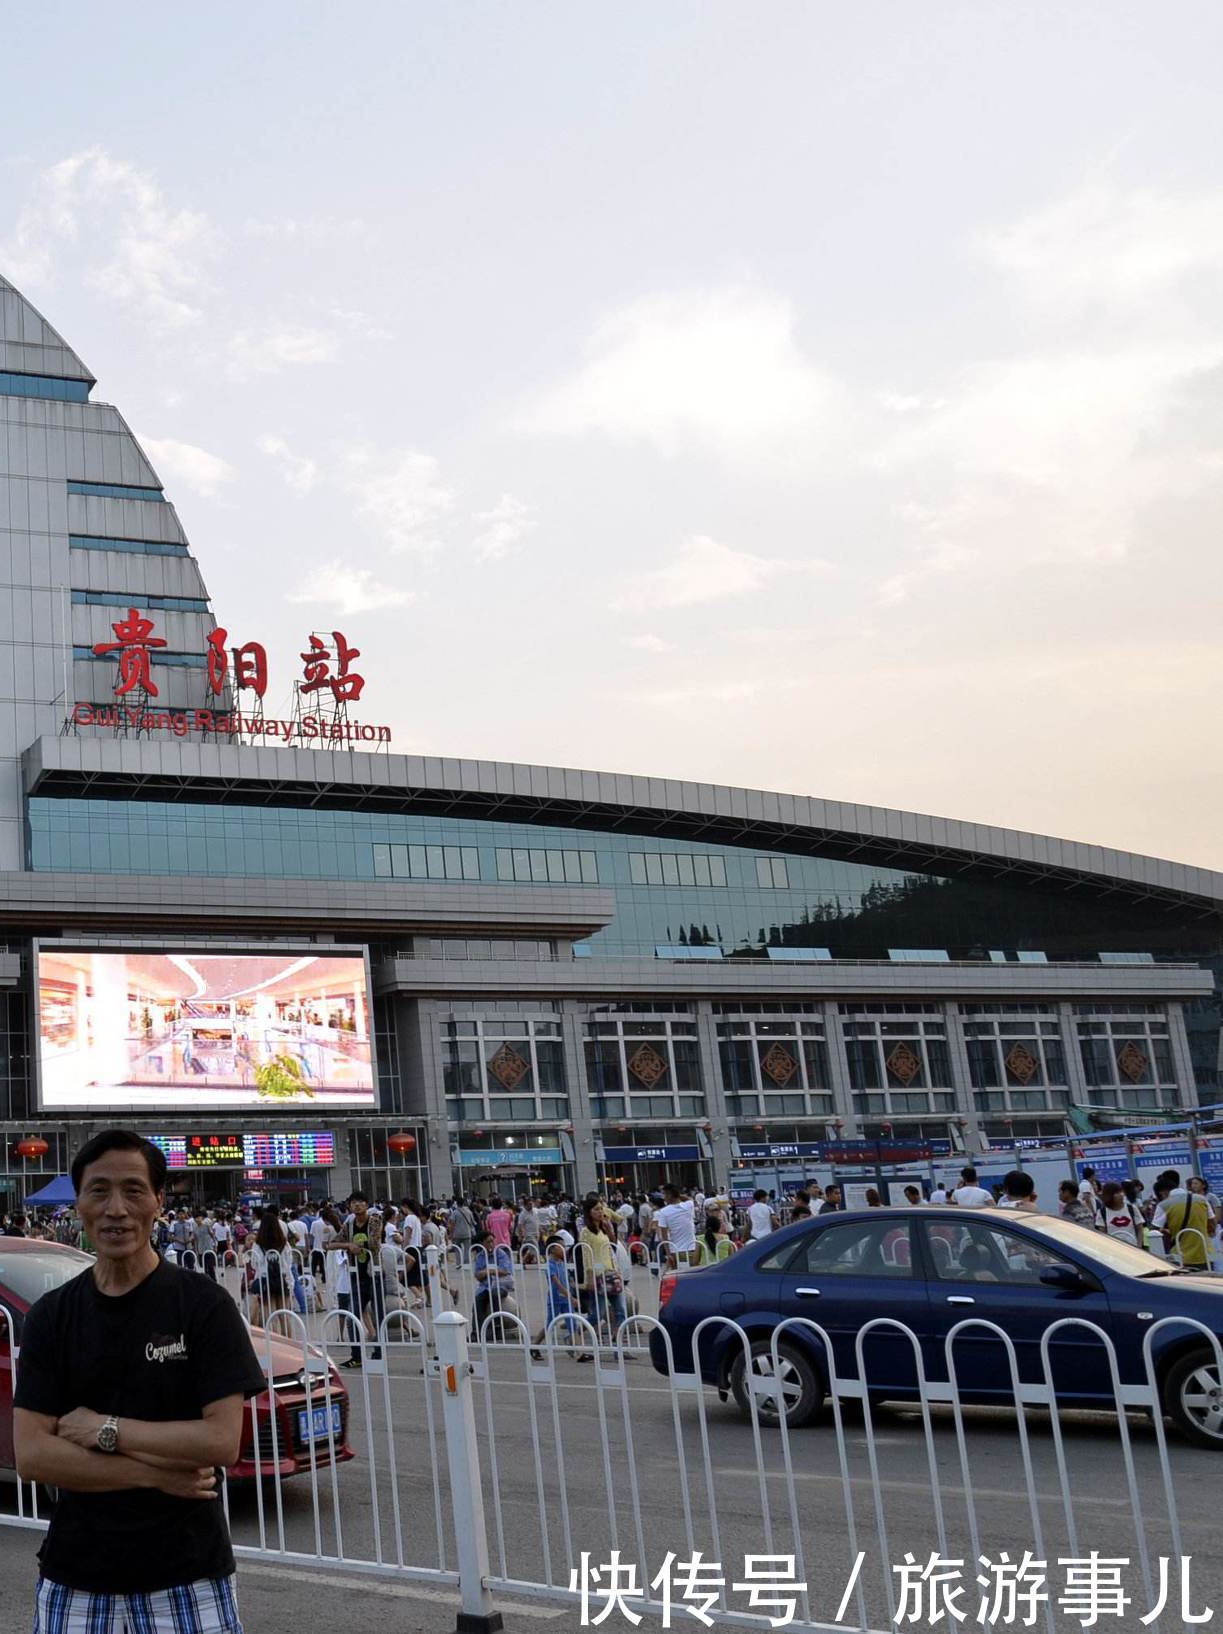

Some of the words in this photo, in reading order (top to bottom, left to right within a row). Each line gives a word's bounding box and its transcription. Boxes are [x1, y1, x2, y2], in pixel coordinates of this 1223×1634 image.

[92, 607, 365, 703] 贵阳站
[72, 702, 118, 726] Gui
[126, 705, 188, 736] Yang
[194, 708, 294, 742] Railway
[302, 715, 392, 743] Station
[191, 1136, 236, 1147] 进站口
[145, 1333, 187, 1363] Cozumel
